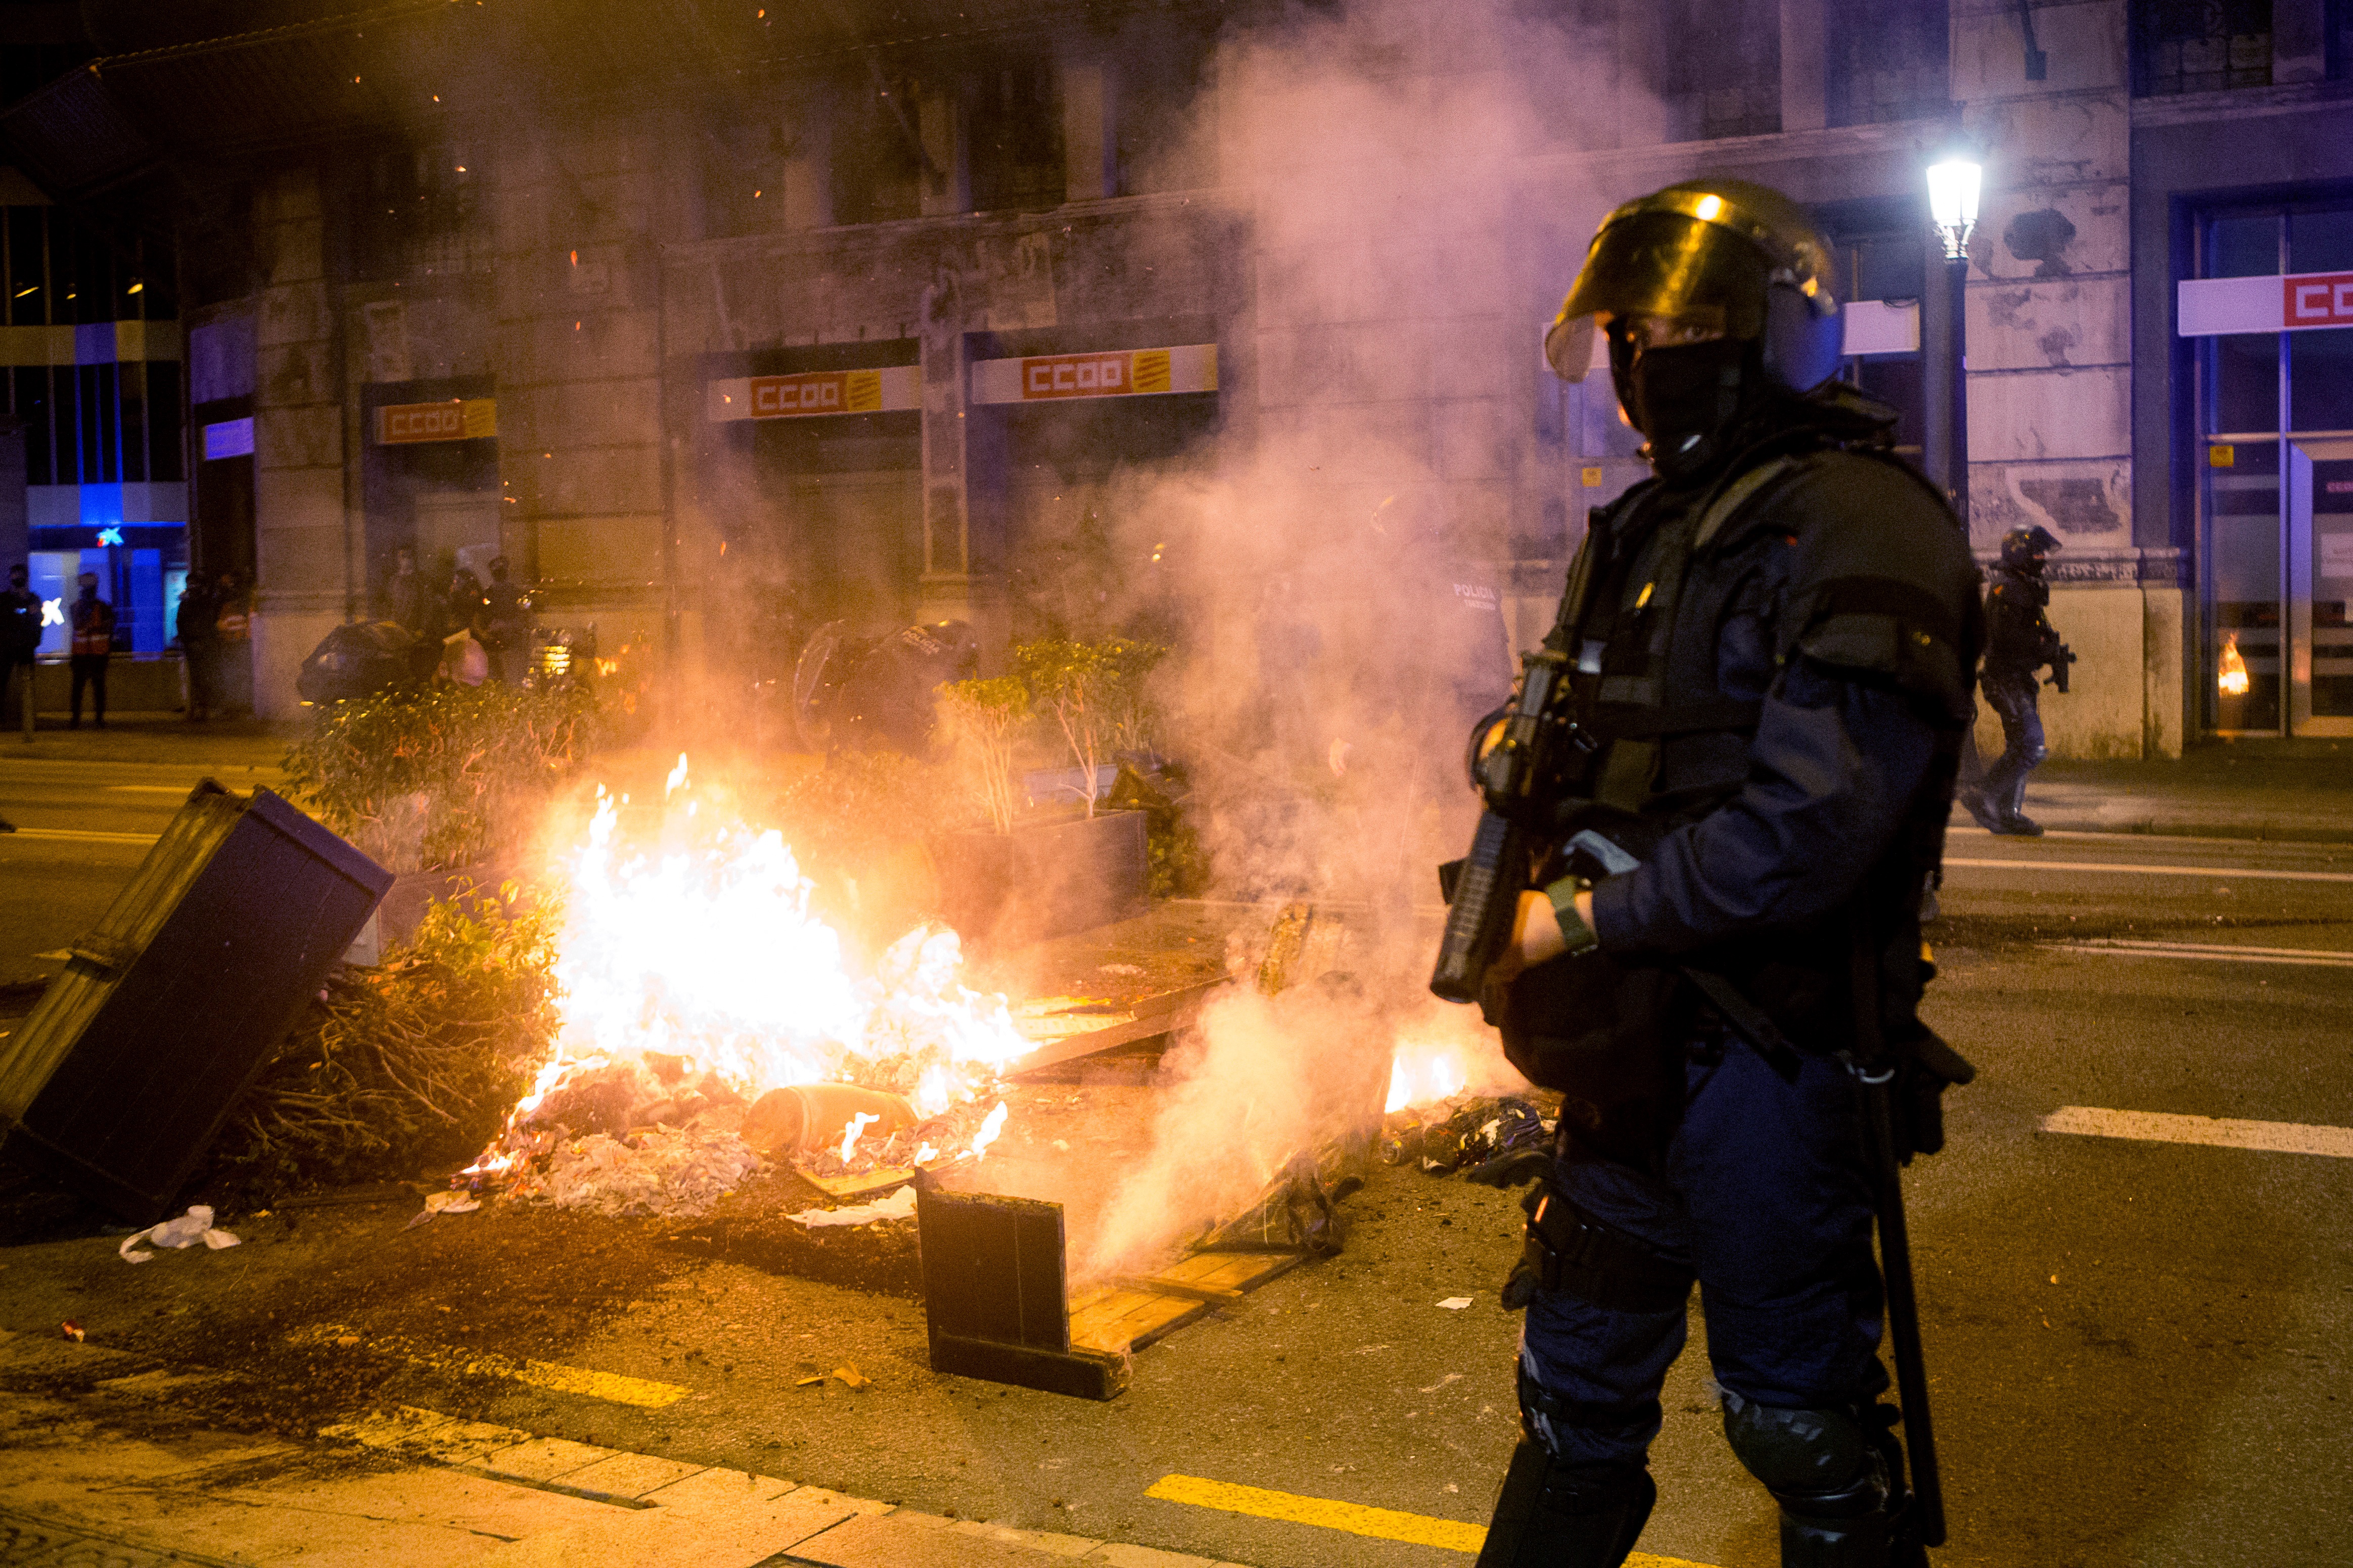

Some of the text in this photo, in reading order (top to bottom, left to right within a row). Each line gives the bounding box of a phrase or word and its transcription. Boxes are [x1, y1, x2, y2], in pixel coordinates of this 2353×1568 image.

[1029, 360, 1122, 392] CCOO
[758, 383, 839, 410] CCOO
[392, 410, 458, 435] CCOO
[1453, 584, 1496, 600] POLICIA
